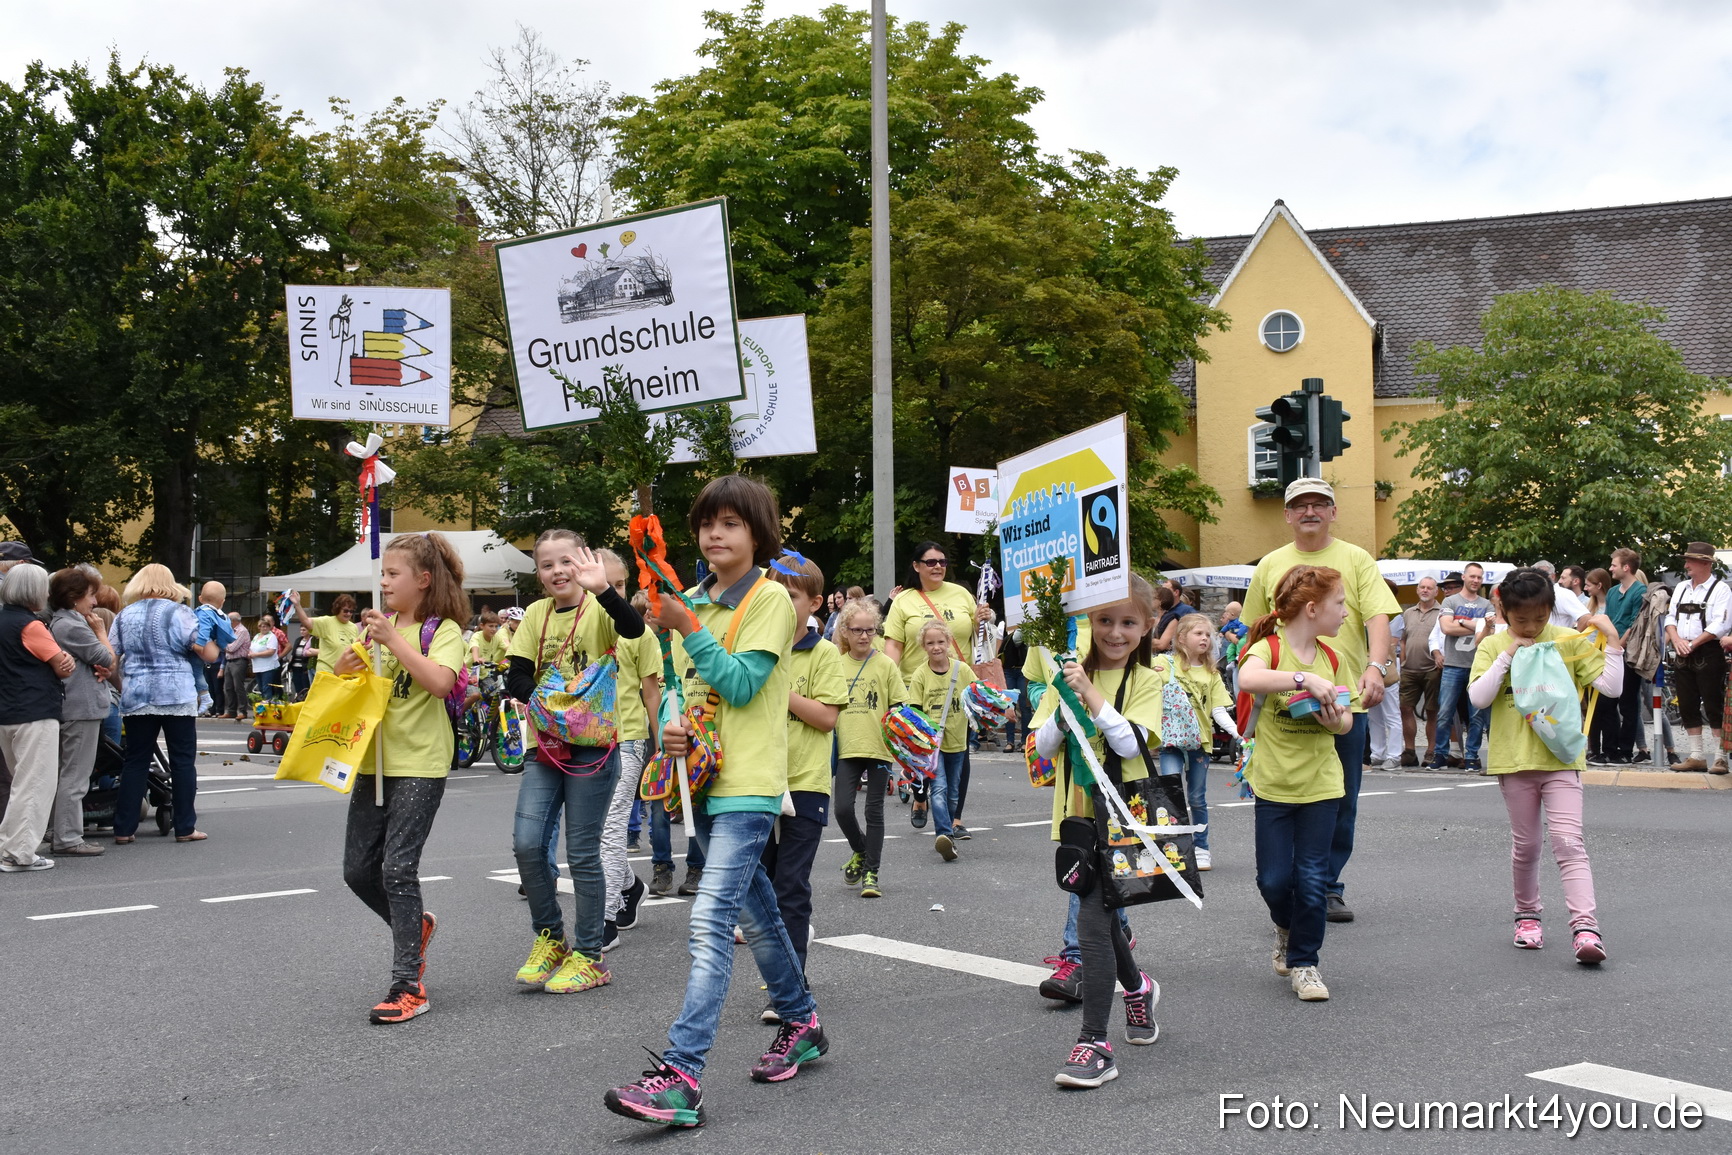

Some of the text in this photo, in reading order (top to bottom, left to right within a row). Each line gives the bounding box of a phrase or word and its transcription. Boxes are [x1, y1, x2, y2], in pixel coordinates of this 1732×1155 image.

[298, 296, 319, 361] SINUS
[527, 310, 716, 368] Grundschule
[742, 336, 775, 378] EUROPA
[311, 398, 328, 409] Wir
[330, 399, 351, 411] sind
[562, 365, 700, 412] Holheim
[755, 382, 778, 436] 21-SCHULE
[1002, 514, 1051, 544] Wir sind
[1003, 530, 1078, 572] Fairtrade
[1085, 554, 1119, 573] FAIRTRADE
